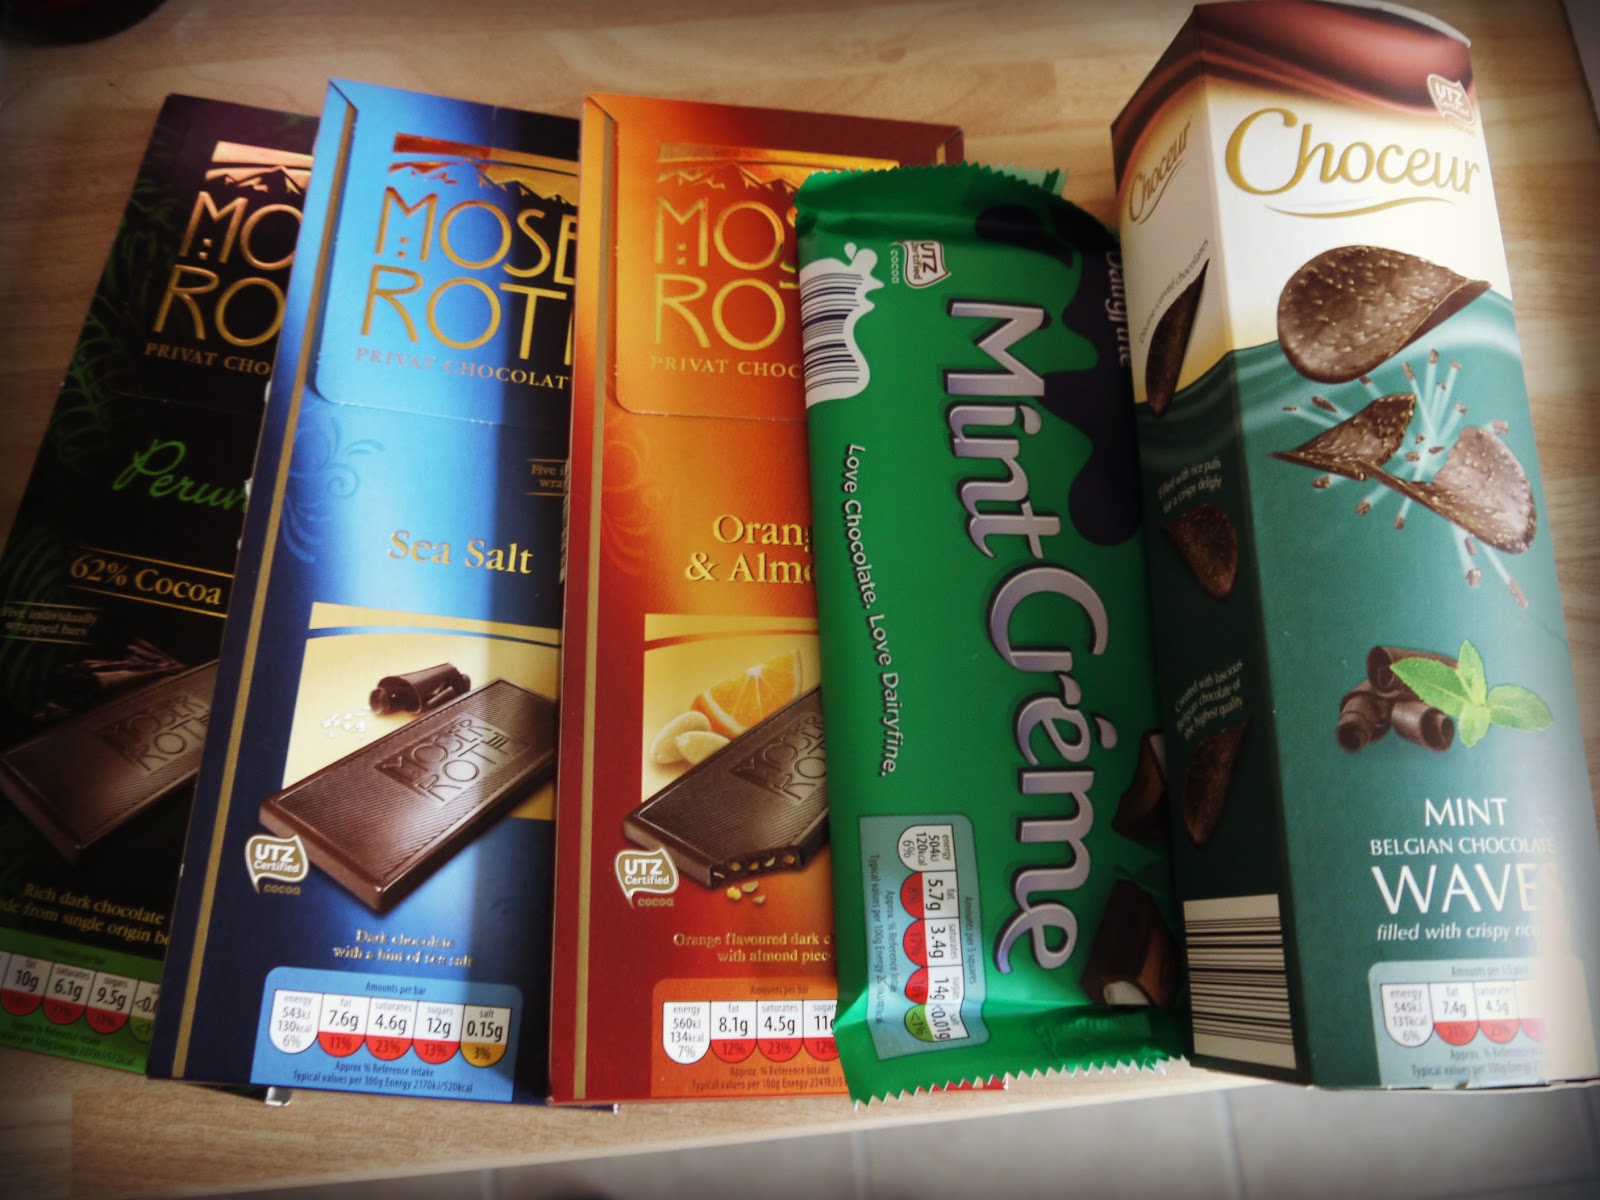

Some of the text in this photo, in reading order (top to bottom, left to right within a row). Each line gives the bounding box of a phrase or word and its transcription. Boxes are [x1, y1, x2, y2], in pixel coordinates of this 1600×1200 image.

[1225, 107, 1480, 195] Choceur
[1129, 115, 1192, 222] Choceur
[921, 242, 938, 273] UTZ
[891, 250, 900, 285] cocoa
[361, 264, 574, 365] ROT
[146, 341, 218, 367] PRIVAT
[357, 347, 568, 390] PRIVAT CHOCOLAT
[651, 355, 729, 374] PRIVAT
[947, 302, 1060, 559] Mint
[388, 530, 534, 575] Sea Salt
[685, 552, 718, 581] &
[70, 554, 222, 605] 62% Cocoa
[844, 443, 905, 777] Love Chocolate. Love Dairyfine.
[1425, 798, 1508, 827] MINT
[255, 843, 296, 863] UTZ
[902, 840, 915, 858] 6%
[916, 832, 927, 866] 120kcal
[941, 835, 952, 861] energy
[1370, 837, 1454, 856] BELGIAN
[253, 860, 300, 874] Certified
[625, 859, 663, 876] UTZ
[870, 854, 880, 881] Typical
[263, 884, 302, 895] cocoa
[625, 874, 669, 886] Certified
[637, 897, 674, 908] cocoa
[872, 883, 881, 908] values
[926, 879, 943, 911] 5.7g
[947, 889, 956, 899] fat
[24, 883, 165, 926] Rich dark chocolate
[23, 903, 59, 922] from
[62, 912, 105, 932] single
[108, 924, 151, 943] origin
[871, 910, 881, 923] per
[356, 929, 388, 944] Dark
[673, 933, 721, 948] Orange
[725, 932, 787, 945] flavoured
[790, 932, 819, 945] dark
[873, 925, 885, 944] 100g
[964, 896, 977, 984] Amounts per squares
[1377, 922, 1511, 943] filled with crispy
[888, 933, 899, 971] Reference
[910, 932, 923, 955] 17%
[929, 927, 945, 958] 3.4g
[332, 945, 363, 959] with
[378, 948, 403, 962] hint
[406, 950, 421, 964] of
[448, 954, 473, 968] salt
[717, 949, 746, 962] with
[750, 949, 798, 962] almond
[874, 946, 886, 973] Energy
[15, 970, 39, 993] 10g
[55, 966, 91, 981] saturates
[104, 976, 129, 989] sugars
[54, 978, 83, 1002] 6.1g
[366, 982, 426, 996] Amounts per bar
[930, 979, 948, 1000] 14g
[96, 987, 127, 1011] 9.5g
[284, 995, 314, 1006] energy
[374, 1000, 412, 1012] saturates
[728, 1003, 739, 1012] fat
[761, 1004, 798, 1013] saturates
[1443, 1000, 1467, 1017] 7.4g
[329, 1010, 359, 1031] 7.6g
[426, 1006, 454, 1018] sugars
[479, 1009, 495, 1019] salt
[673, 1006, 701, 1016] energy
[949, 1014, 959, 1025] salt
[277, 1020, 312, 1034] 130kcal
[375, 1014, 407, 1035] 4.6g
[427, 1018, 451, 1038] 12g
[467, 1020, 503, 1042] 0.15g
[719, 1016, 748, 1036] 8.1g
[764, 1015, 795, 1034] 4.5g
[283, 1034, 302, 1048] 6%
[330, 1035, 352, 1050] 11%
[670, 1031, 704, 1043] 134kcal
[1402, 1029, 1420, 1042] 6%
[375, 1039, 401, 1054] 23%
[424, 1042, 447, 1057] 13%
[474, 1046, 491, 1060] 3%
[678, 1045, 696, 1058] 7%
[722, 1043, 745, 1055] 12%
[768, 1042, 791, 1055] 23%
[373, 1064, 435, 1078] Reference Intake
[769, 1065, 806, 1075] Reference
[806, 1064, 829, 1074] Intake
[293, 1070, 321, 1084] Typical
[322, 1073, 348, 1084] values
[349, 1076, 363, 1087] per
[385, 1076, 412, 1090] Energy
[692, 1079, 720, 1090] Typical
[721, 1079, 744, 1088] values
[745, 1079, 759, 1090] per
[782, 1077, 807, 1089] Energy
